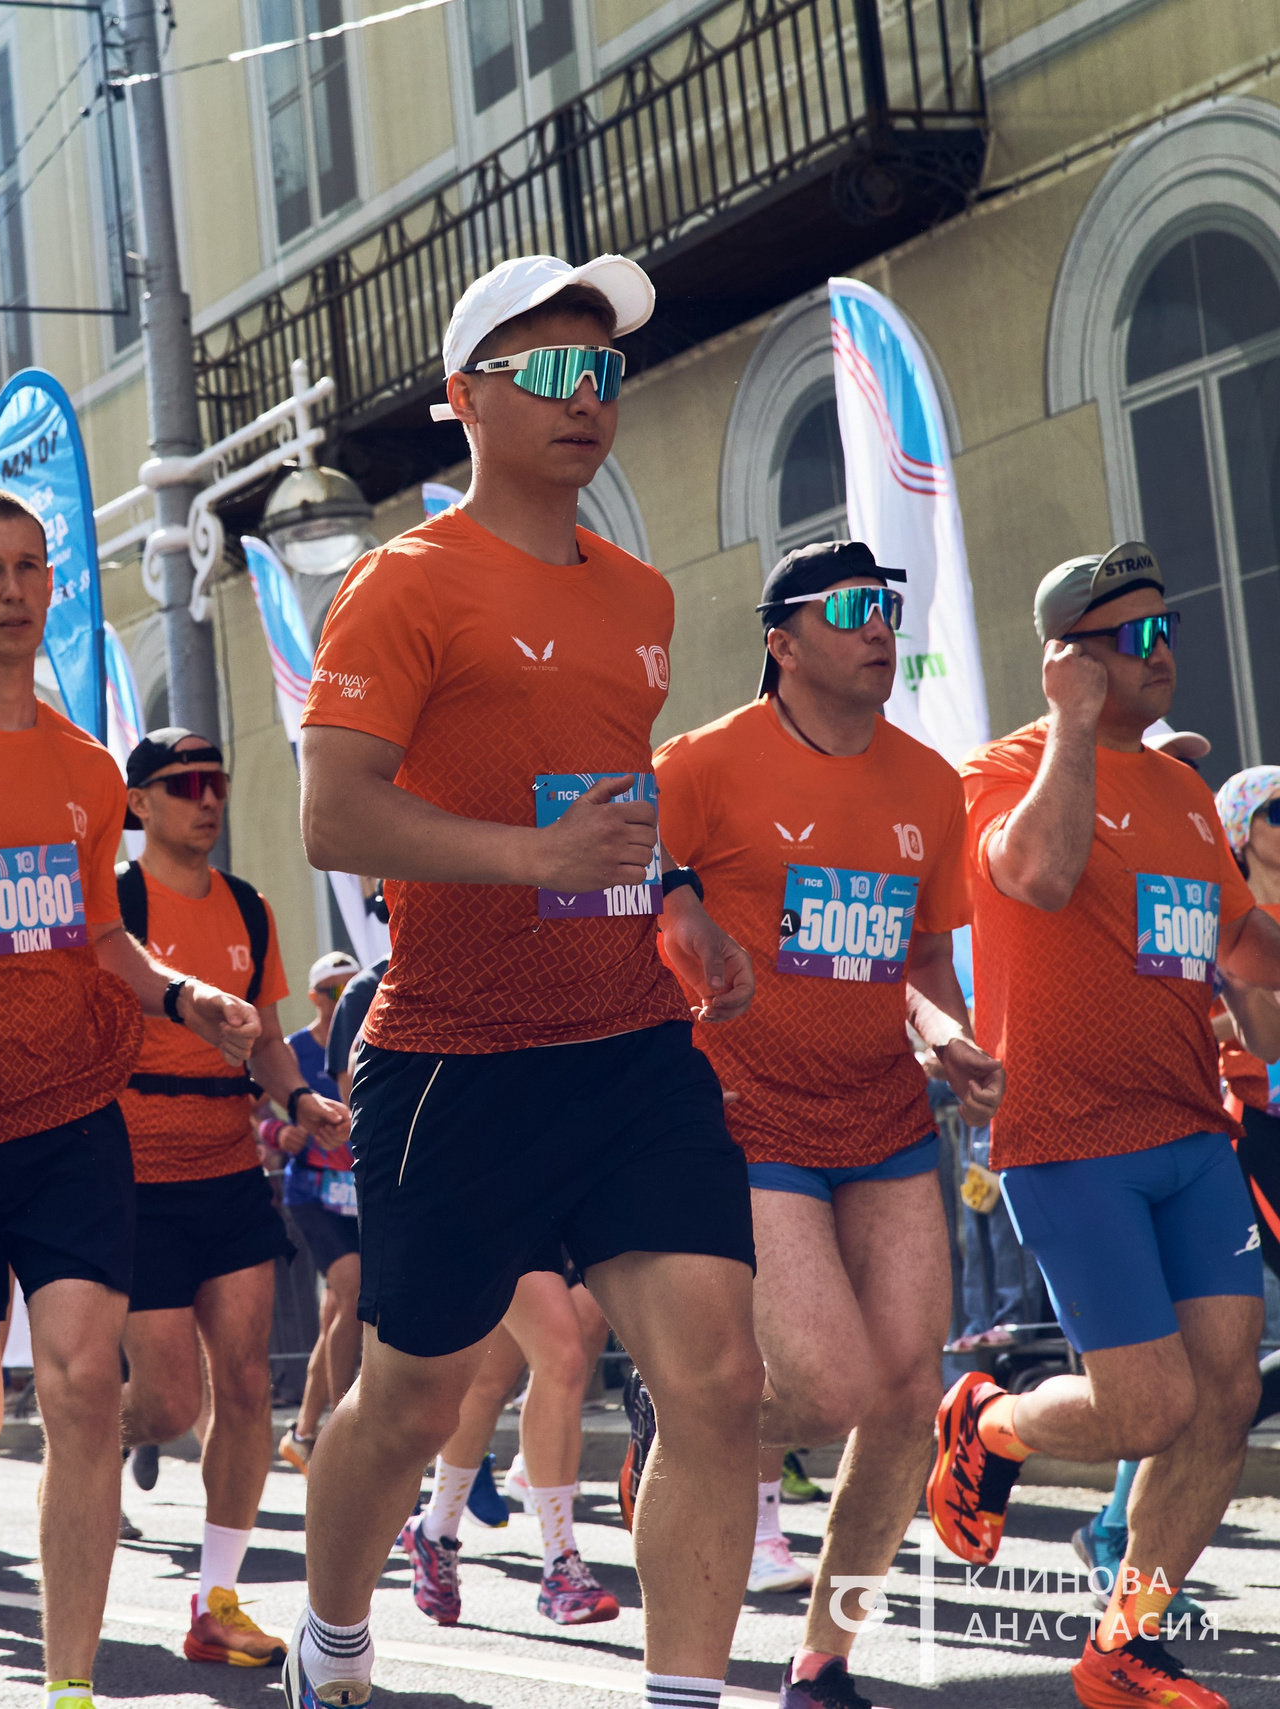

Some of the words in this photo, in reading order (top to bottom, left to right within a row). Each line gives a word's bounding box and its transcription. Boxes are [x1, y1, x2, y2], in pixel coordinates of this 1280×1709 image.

[1105, 555, 1154, 577] STRAVA
[636, 645, 669, 690] 10
[341, 687, 366, 700] RUN
[558, 791, 580, 801] ПСБ
[893, 823, 924, 861] 10
[14, 851, 35, 873] 10
[804, 878, 823, 887] ПСБ
[850, 876, 870, 899] 10
[1185, 884, 1202, 905] 10
[604, 884, 652, 916] 10KM
[781, 914, 793, 932] A
[798, 898, 904, 958] 50035
[11, 927, 52, 954] 10KM
[227, 944, 250, 971] 10
[832, 956, 872, 982] 10KM
[1181, 957, 1207, 982] 10KM
